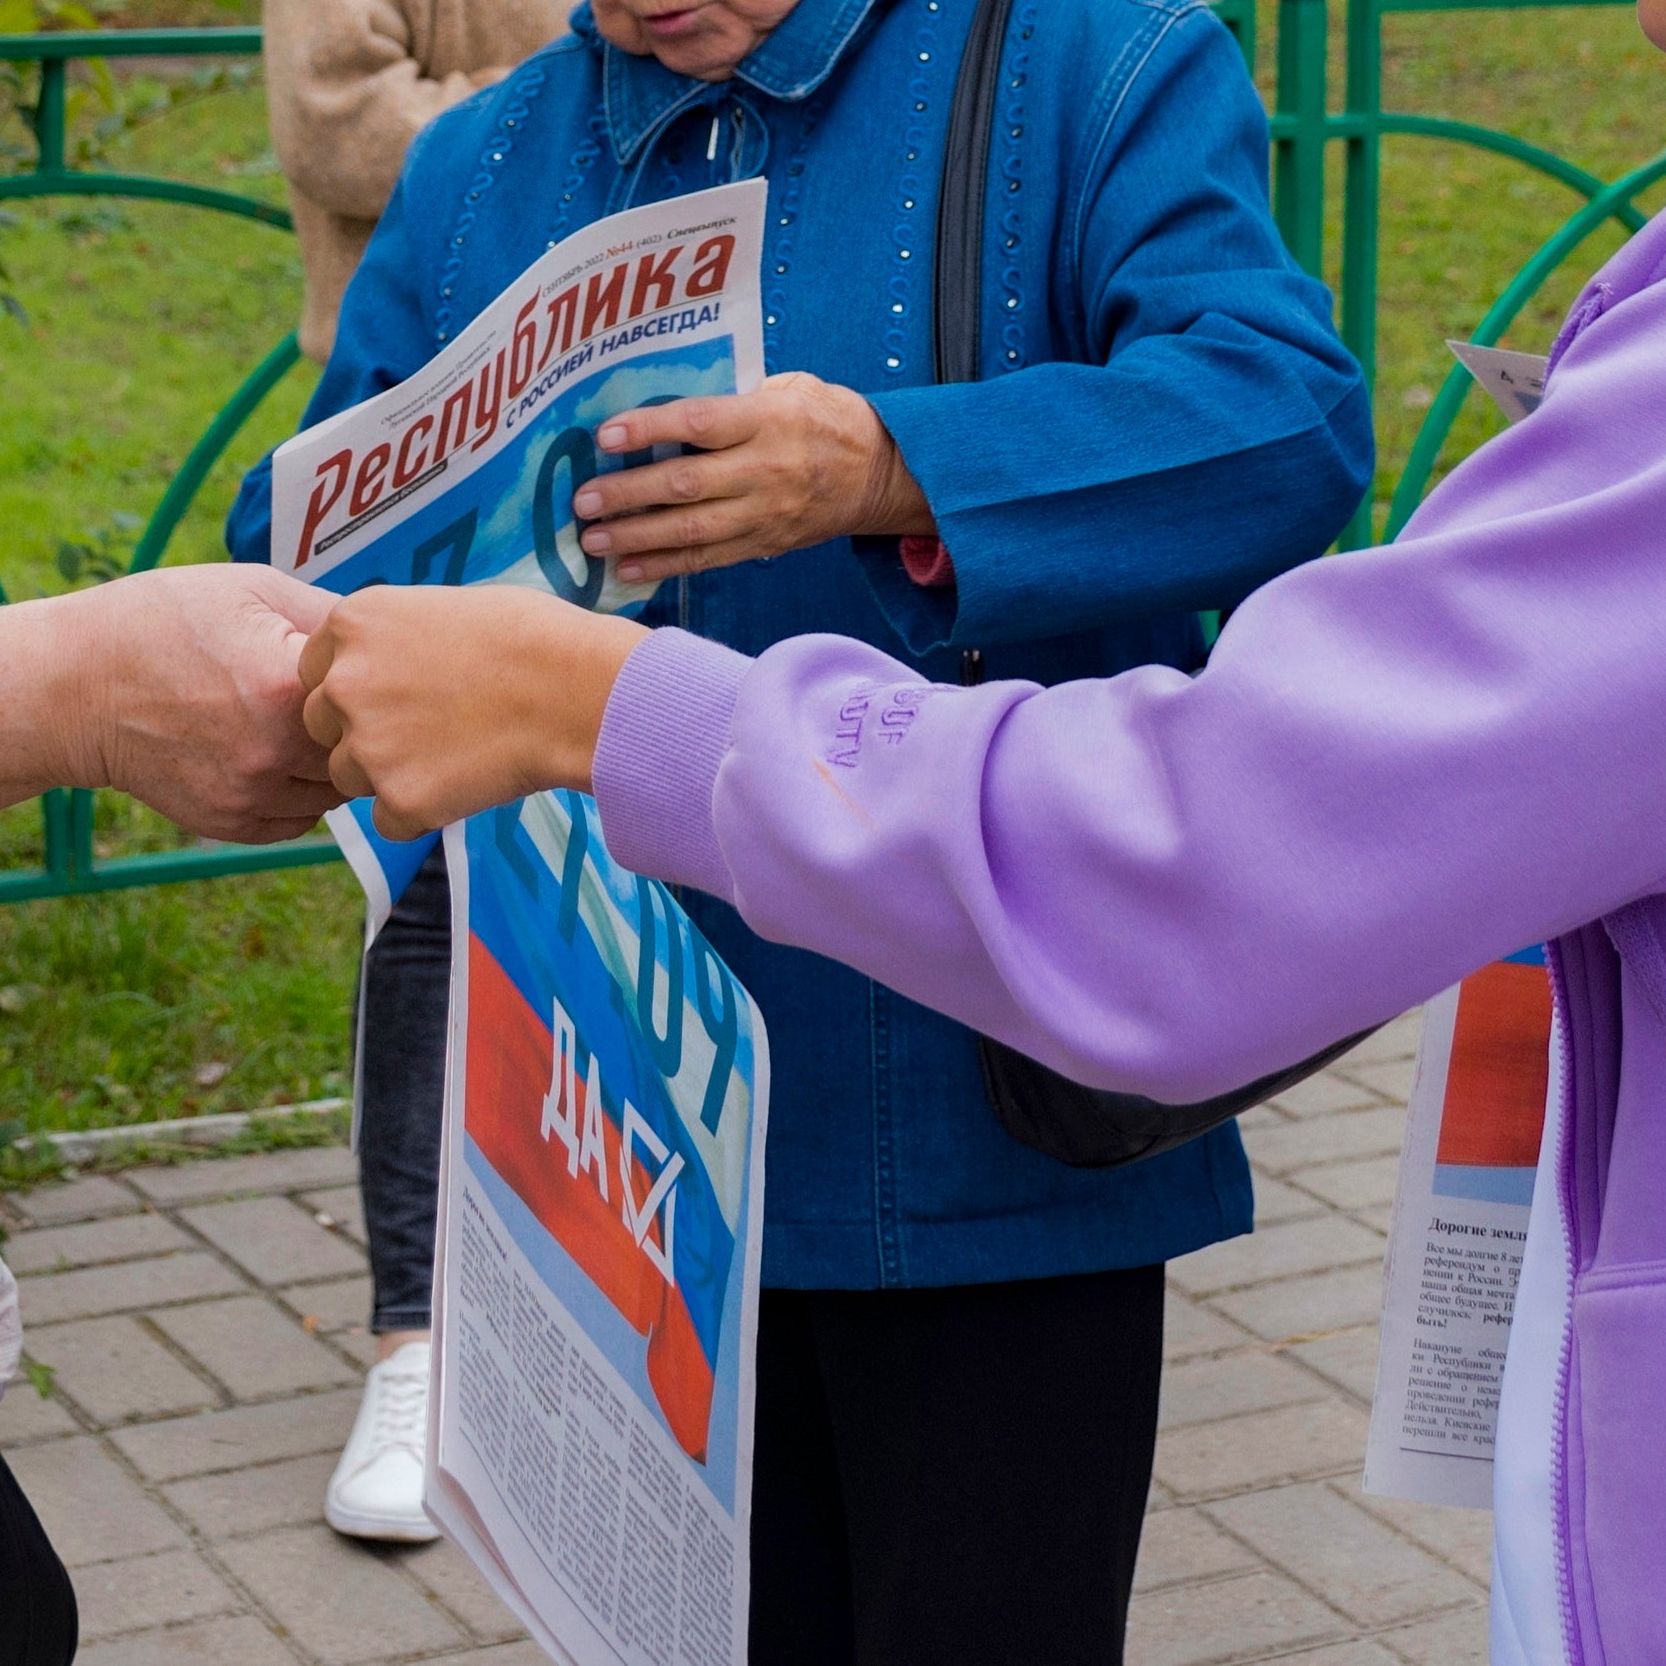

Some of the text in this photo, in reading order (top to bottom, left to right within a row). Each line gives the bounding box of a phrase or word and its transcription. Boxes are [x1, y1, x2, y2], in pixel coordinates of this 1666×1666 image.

[583, 253, 604, 270] 2022
[605, 240, 633, 260] №44
[667, 216, 738, 240] Спецвыпуск
[505, 302, 721, 430] С РОССИЕЙ НАВСЕГДА!
[294, 234, 737, 570] Республика
[1428, 1217, 1487, 1237] Дорогие
[1426, 1242, 1445, 1254] Все
[1447, 1247, 1463, 1256] мы
[1464, 1249, 1499, 1262] долгие
[1500, 1252, 1507, 1261] 8
[1424, 1255, 1522, 1278] референдум о пр
[1423, 1268, 1454, 1280] нении
[1457, 1273, 1464, 1281] к
[1467, 1274, 1504, 1286] России.
[1421, 1280, 1447, 1291] наша
[1451, 1284, 1483, 1296] общая
[1419, 1292, 1451, 1304] общее
[1416, 1315, 1448, 1328] быть!
[1482, 1313, 1514, 1327] рефер
[1413, 1338, 1463, 1354] Накануне
[1412, 1353, 1424, 1361] ки
[1432, 1354, 1492, 1370] Республики
[1437, 1369, 1499, 1383] обращением
[1408, 1376, 1452, 1390] решение
[1477, 1385, 1501, 1396] неме
[1407, 1389, 1500, 1409] проведении рефер
[1444, 1417, 1491, 1431] Киевские
[1402, 1425, 1496, 1445] перешли все крас
